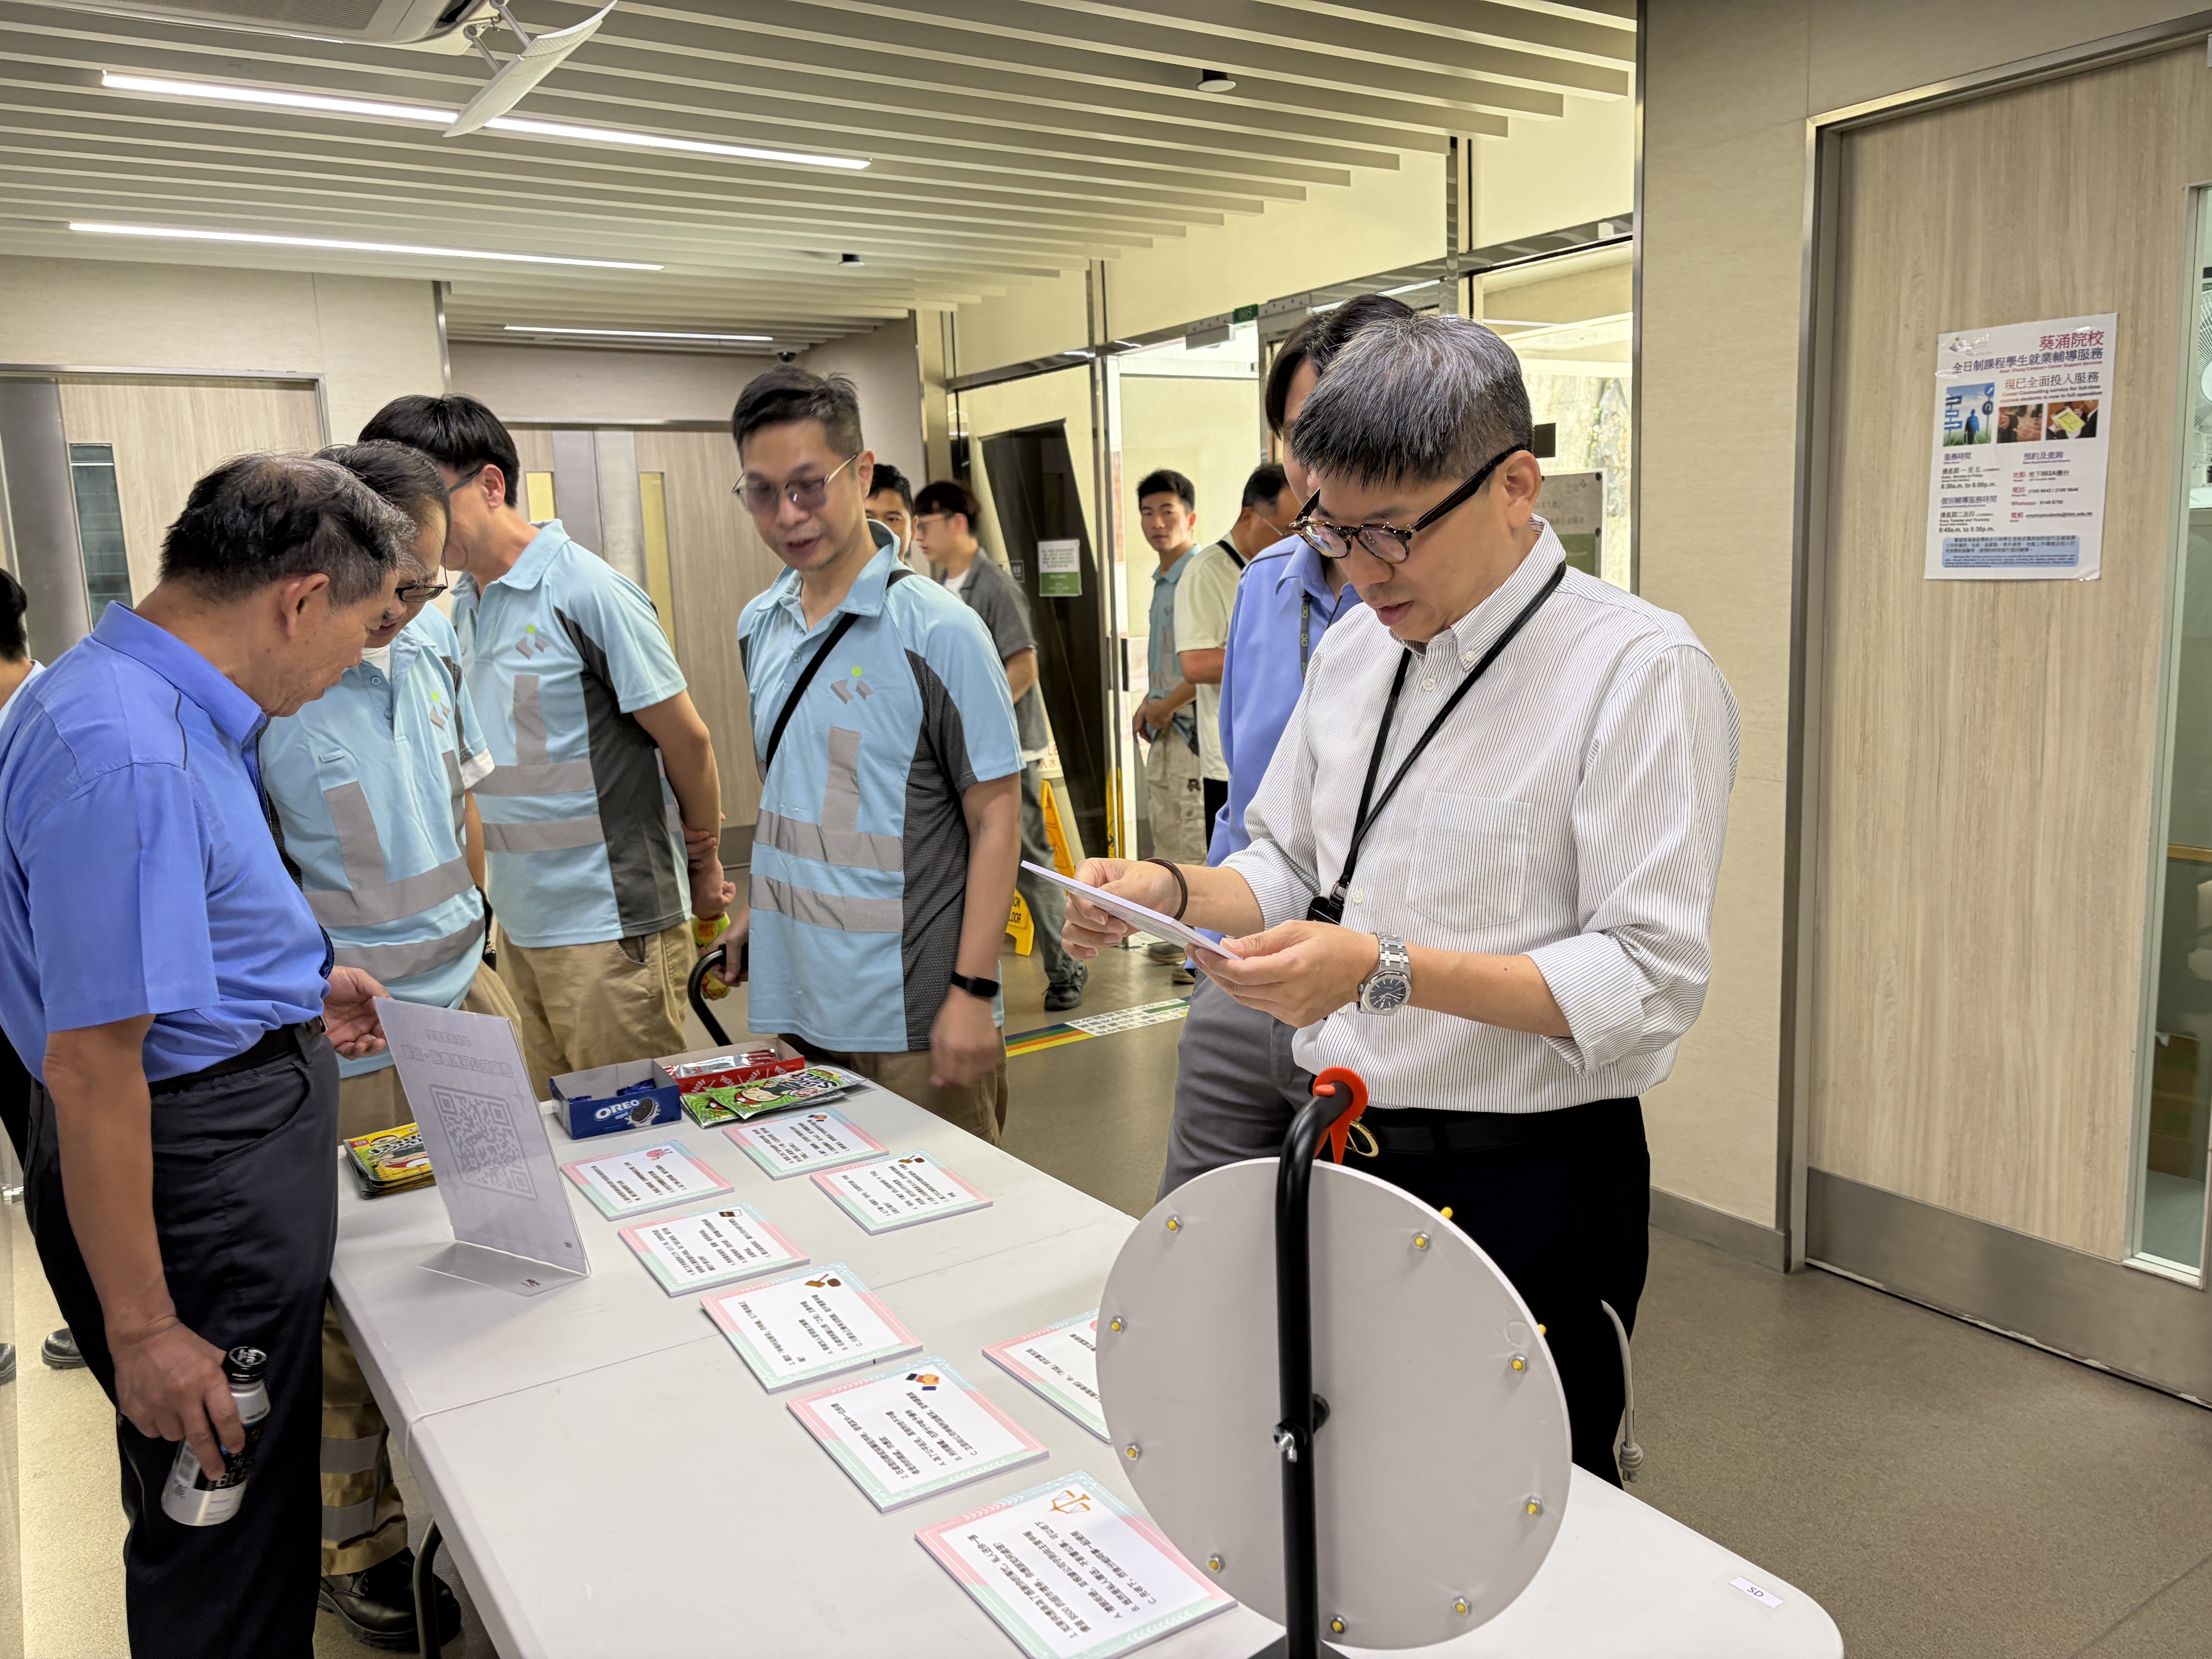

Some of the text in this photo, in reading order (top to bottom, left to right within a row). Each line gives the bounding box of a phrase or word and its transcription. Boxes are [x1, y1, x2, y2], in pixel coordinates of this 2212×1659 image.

[2039, 331, 2105, 352] 葵涌院校
[1952, 348, 2103, 373] 全日制課程學生就業輔導服務
[2005, 371, 2099, 390] 現已全面投入服務
[595, 1099, 640, 1120] OREO
[1747, 1587, 1764, 1597] SD
